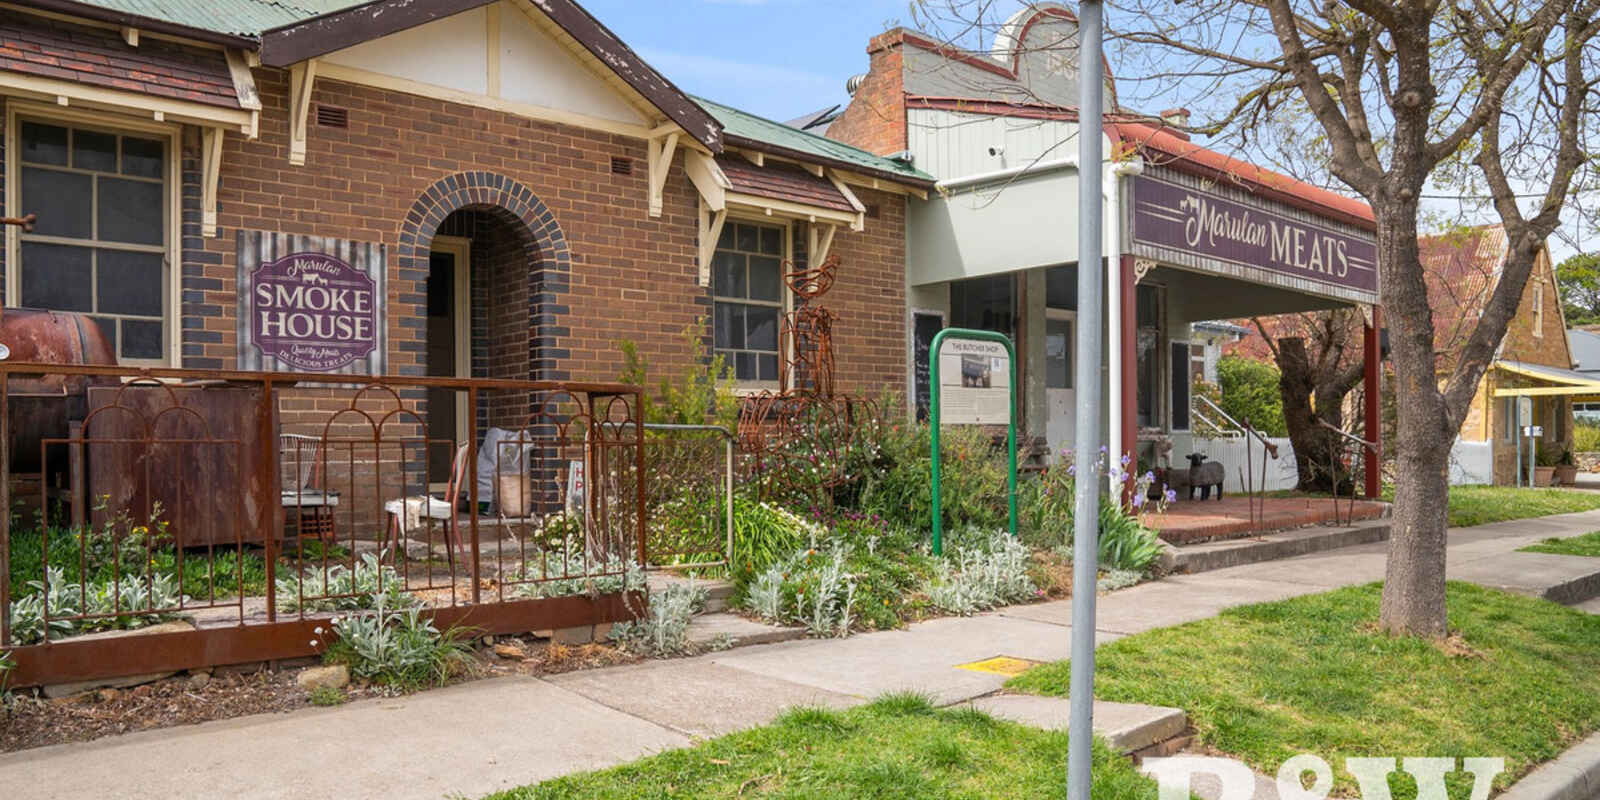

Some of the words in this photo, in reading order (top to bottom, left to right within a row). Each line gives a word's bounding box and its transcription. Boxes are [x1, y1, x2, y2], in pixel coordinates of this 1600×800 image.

[1186, 199, 1268, 247] Marulan
[1270, 220, 1349, 278] MEATS
[287, 259, 341, 277] Marulan
[256, 282, 371, 313] SMOKE
[260, 311, 373, 341] HOUSE
[279, 350, 322, 368] DELICIOUS
[952, 342, 962, 352] THE
[986, 344, 1000, 353] SHOP
